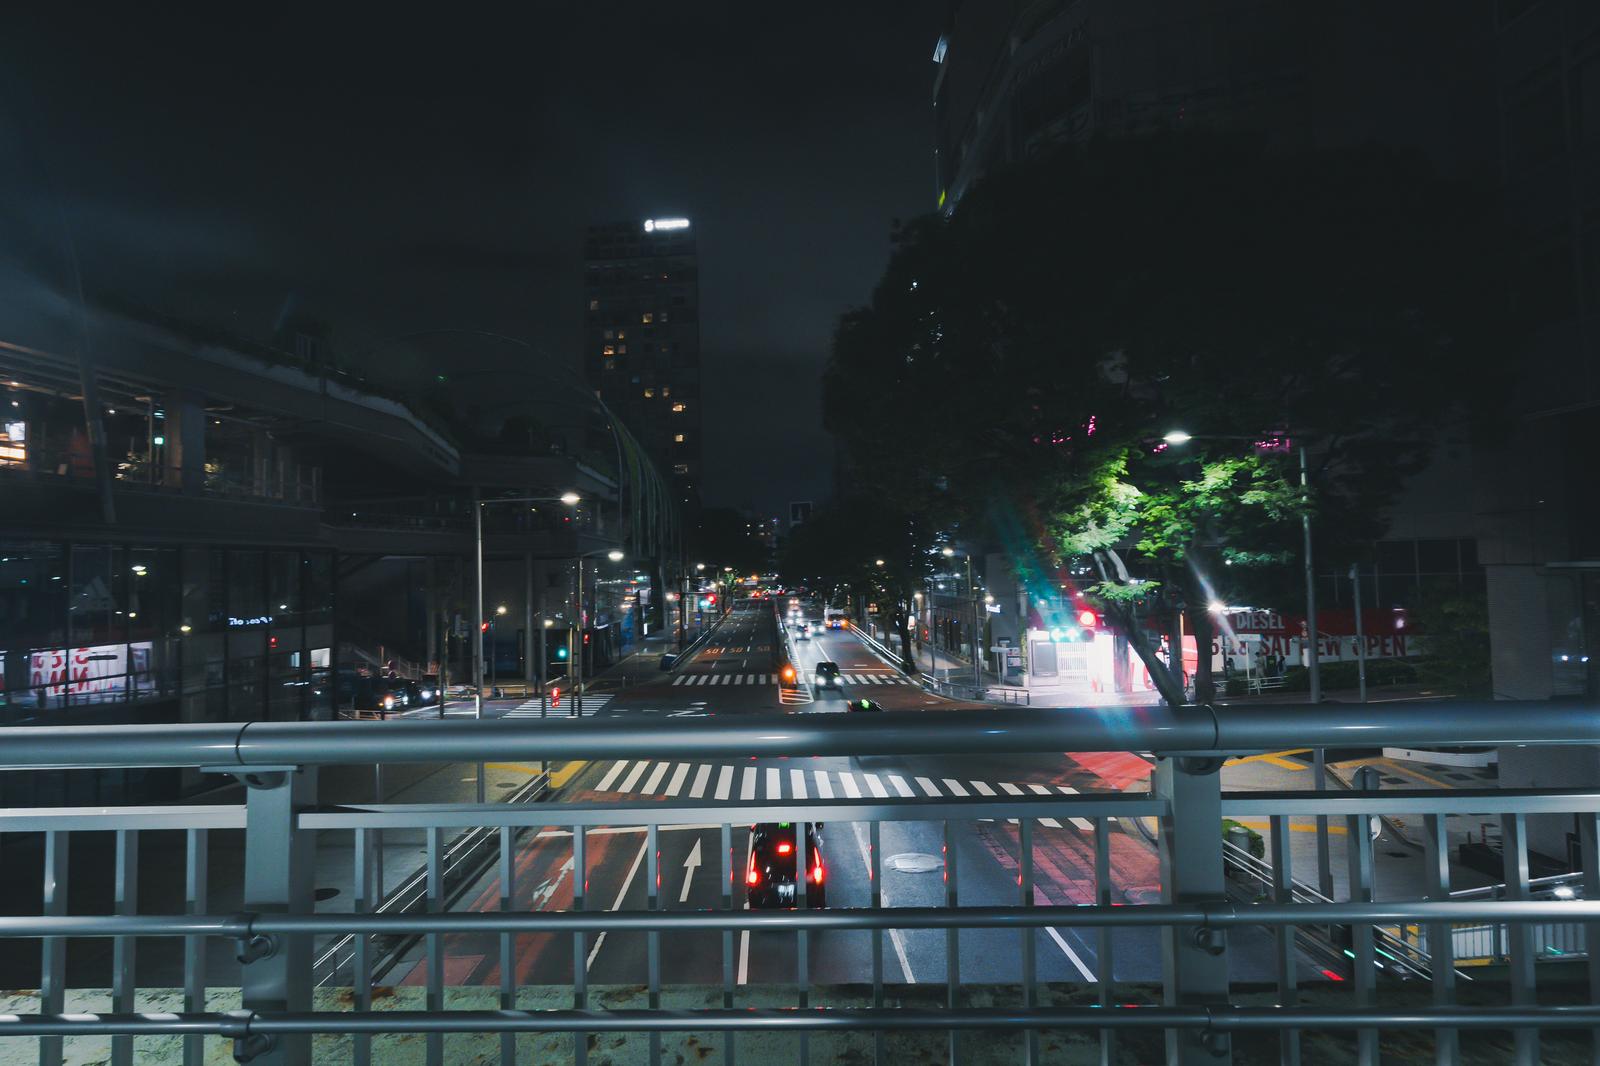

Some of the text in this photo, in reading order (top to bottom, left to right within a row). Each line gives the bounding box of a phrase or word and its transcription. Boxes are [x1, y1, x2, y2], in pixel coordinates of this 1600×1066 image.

[1236, 612, 1285, 630] DIESEL
[1261, 634, 1293, 656] SAT
[1299, 635, 1341, 656] EW
